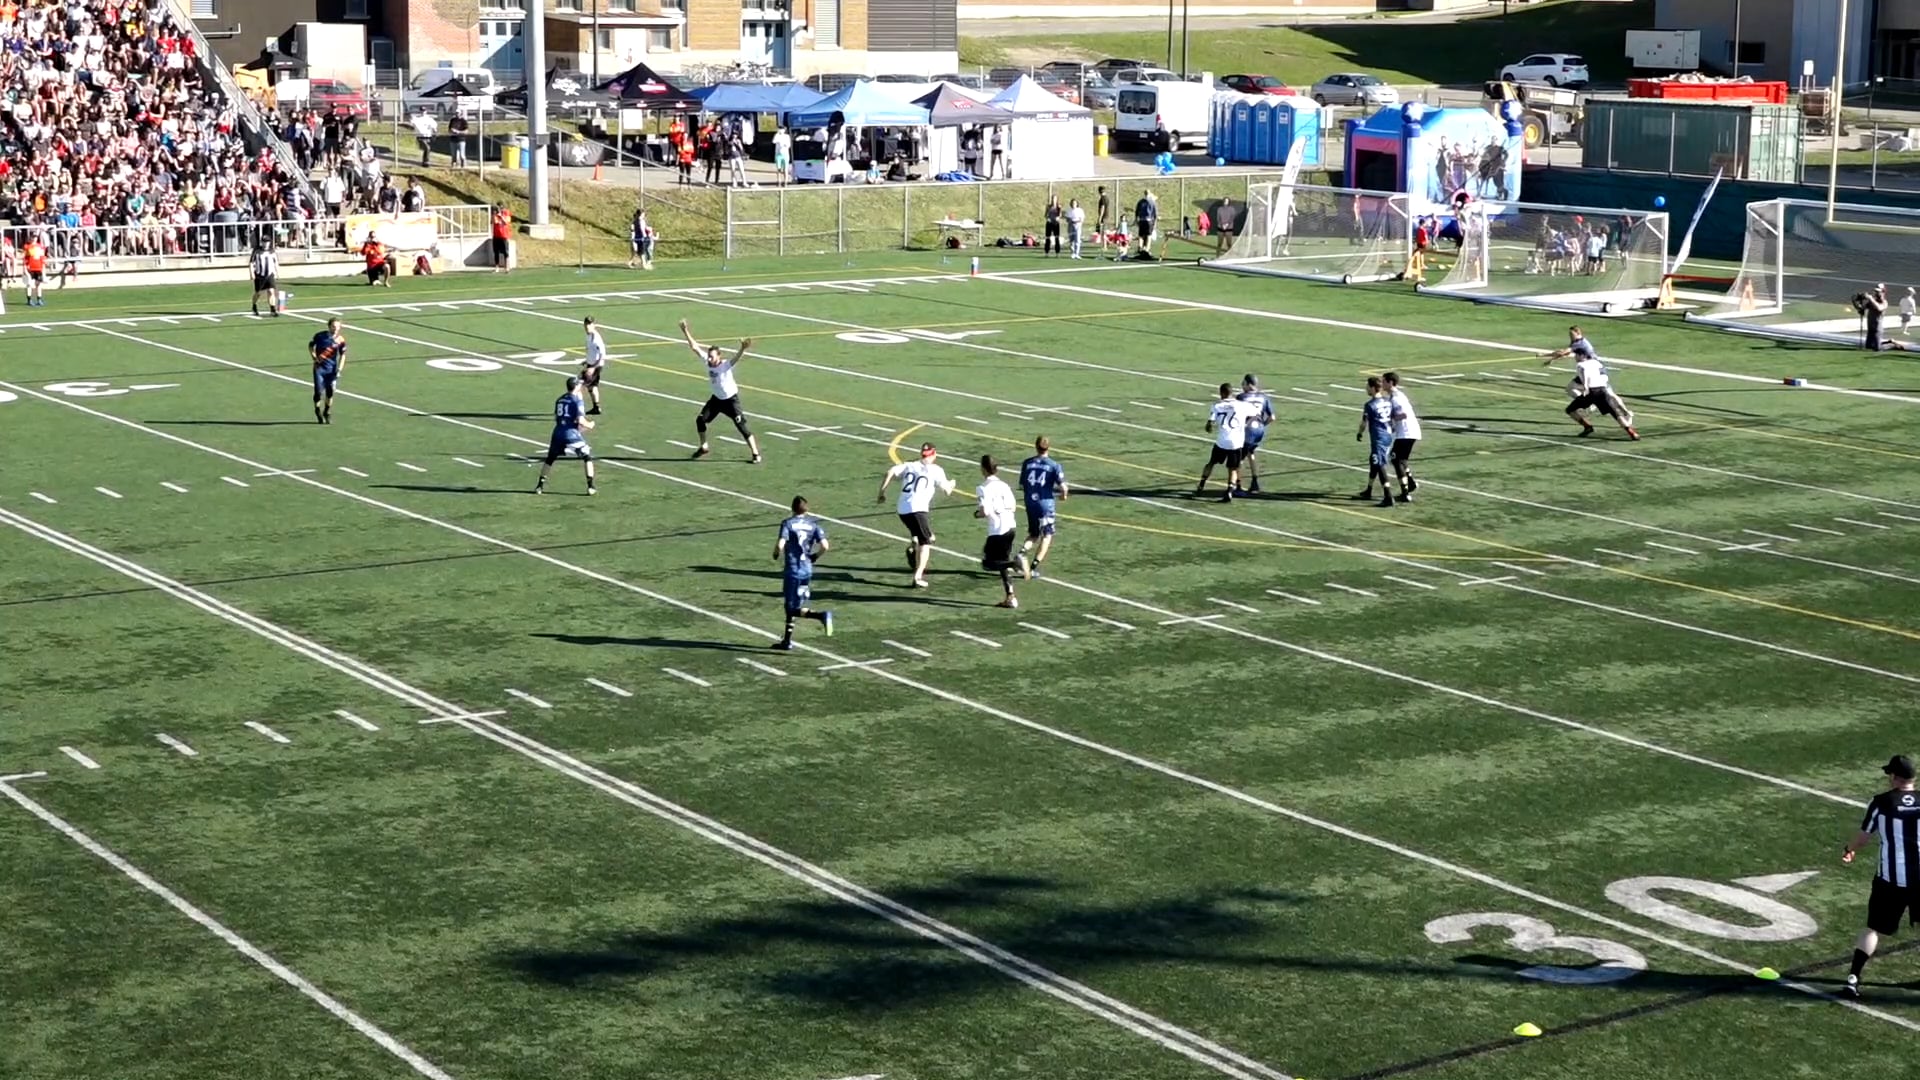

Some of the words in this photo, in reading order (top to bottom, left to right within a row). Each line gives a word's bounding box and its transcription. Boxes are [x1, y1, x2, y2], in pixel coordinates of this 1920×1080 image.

[557, 403, 570, 417] 81
[1217, 412, 1240, 429] 76
[902, 471, 929, 494] 20
[1026, 470, 1047, 486] 44
[1424, 876, 1819, 984] 30
